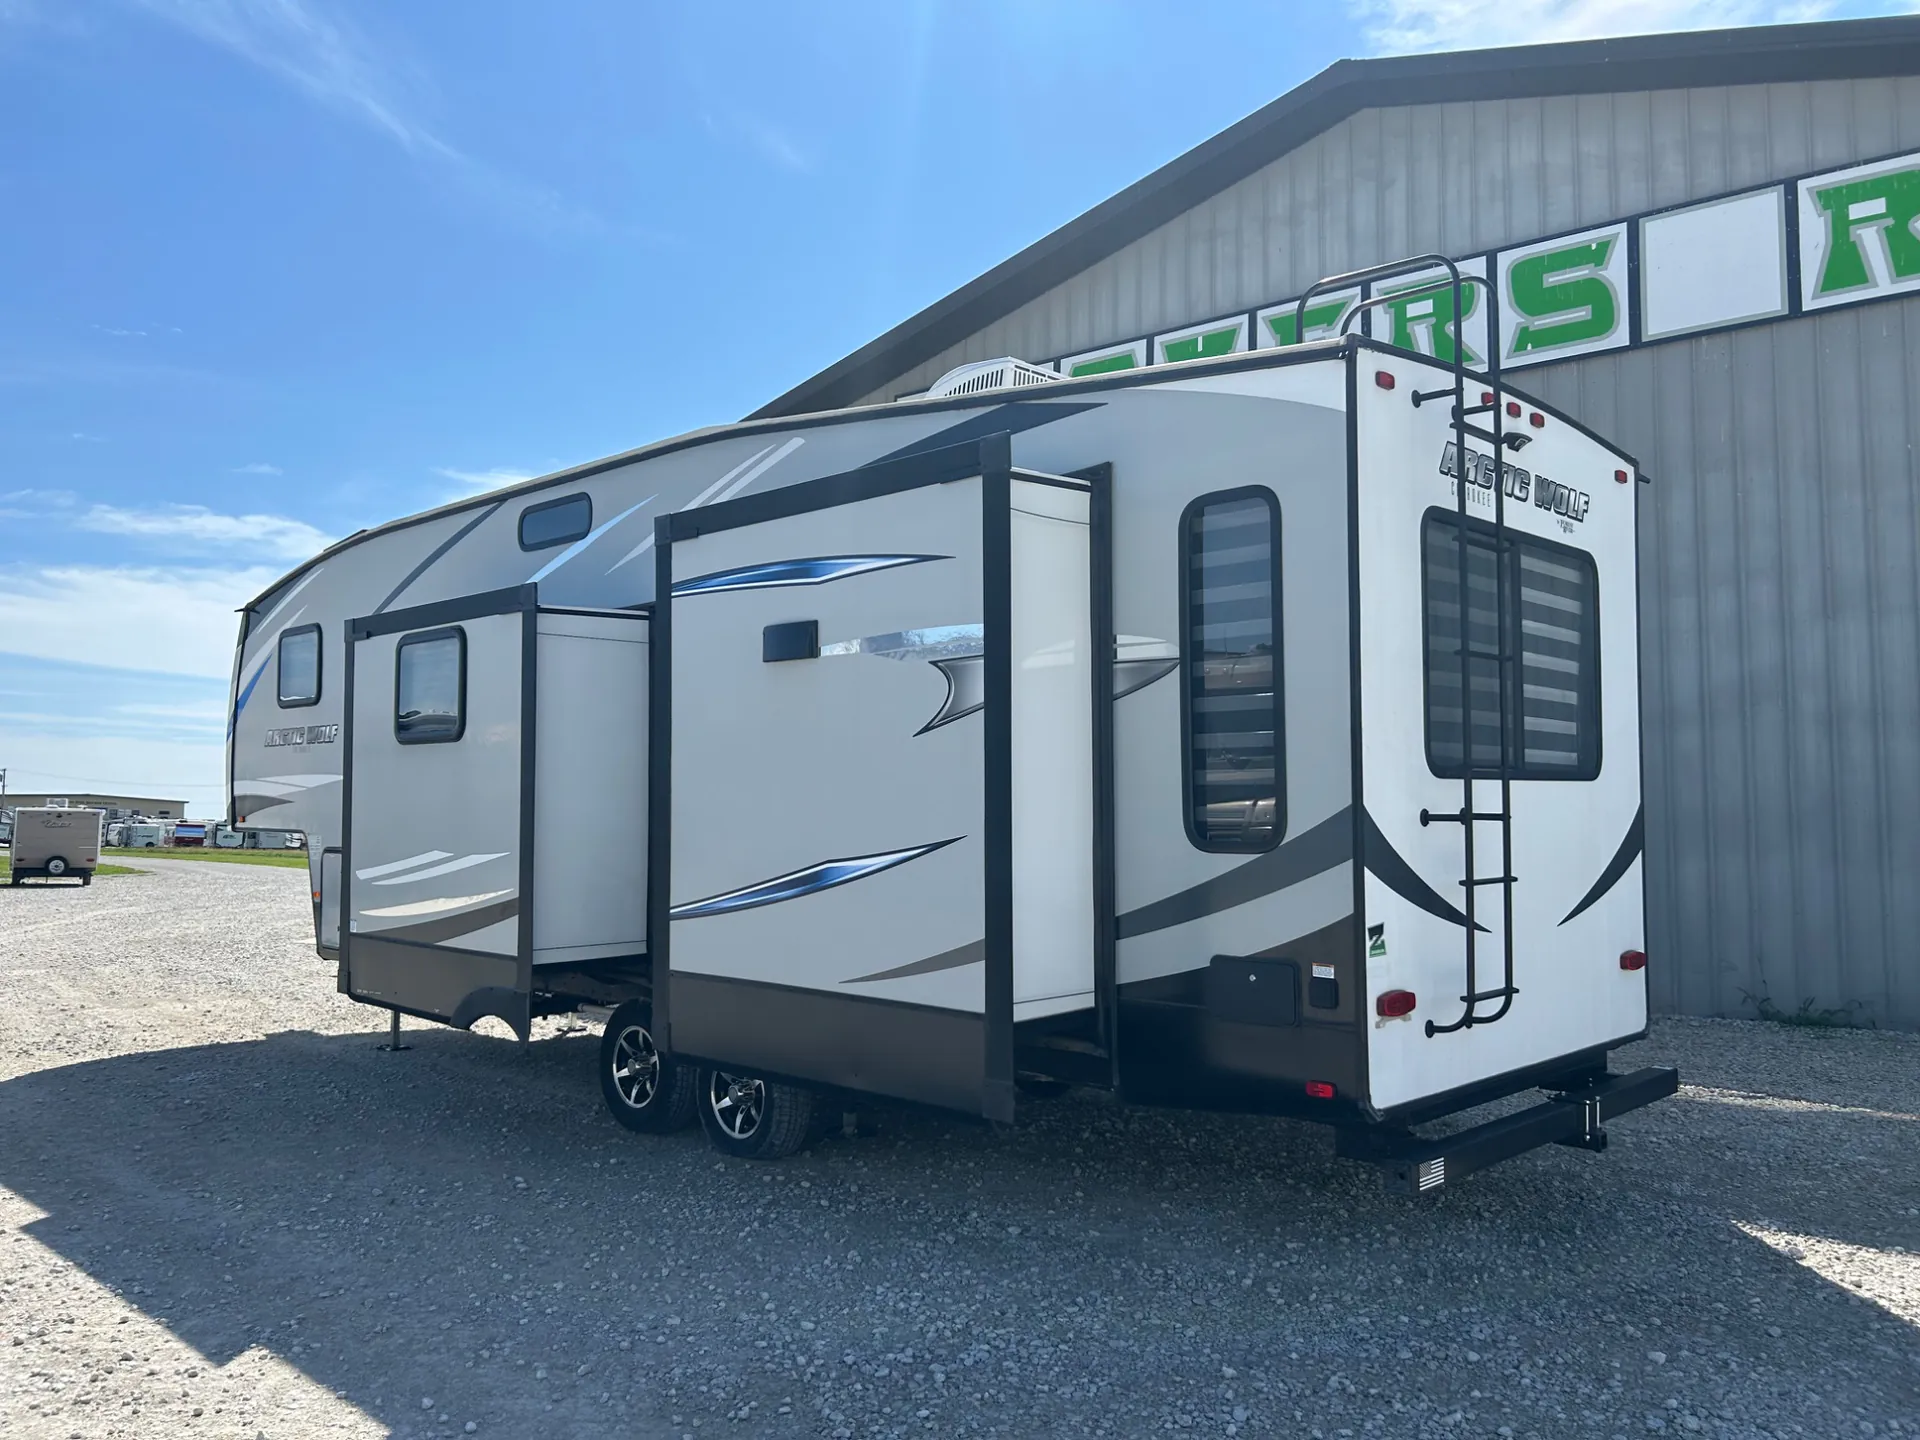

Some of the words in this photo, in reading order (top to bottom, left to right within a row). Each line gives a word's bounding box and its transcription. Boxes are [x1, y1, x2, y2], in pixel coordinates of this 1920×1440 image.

[1534, 474, 1589, 523] WOLF
[264, 727, 305, 747] ARCTIC
[306, 723, 339, 744] WOLF
